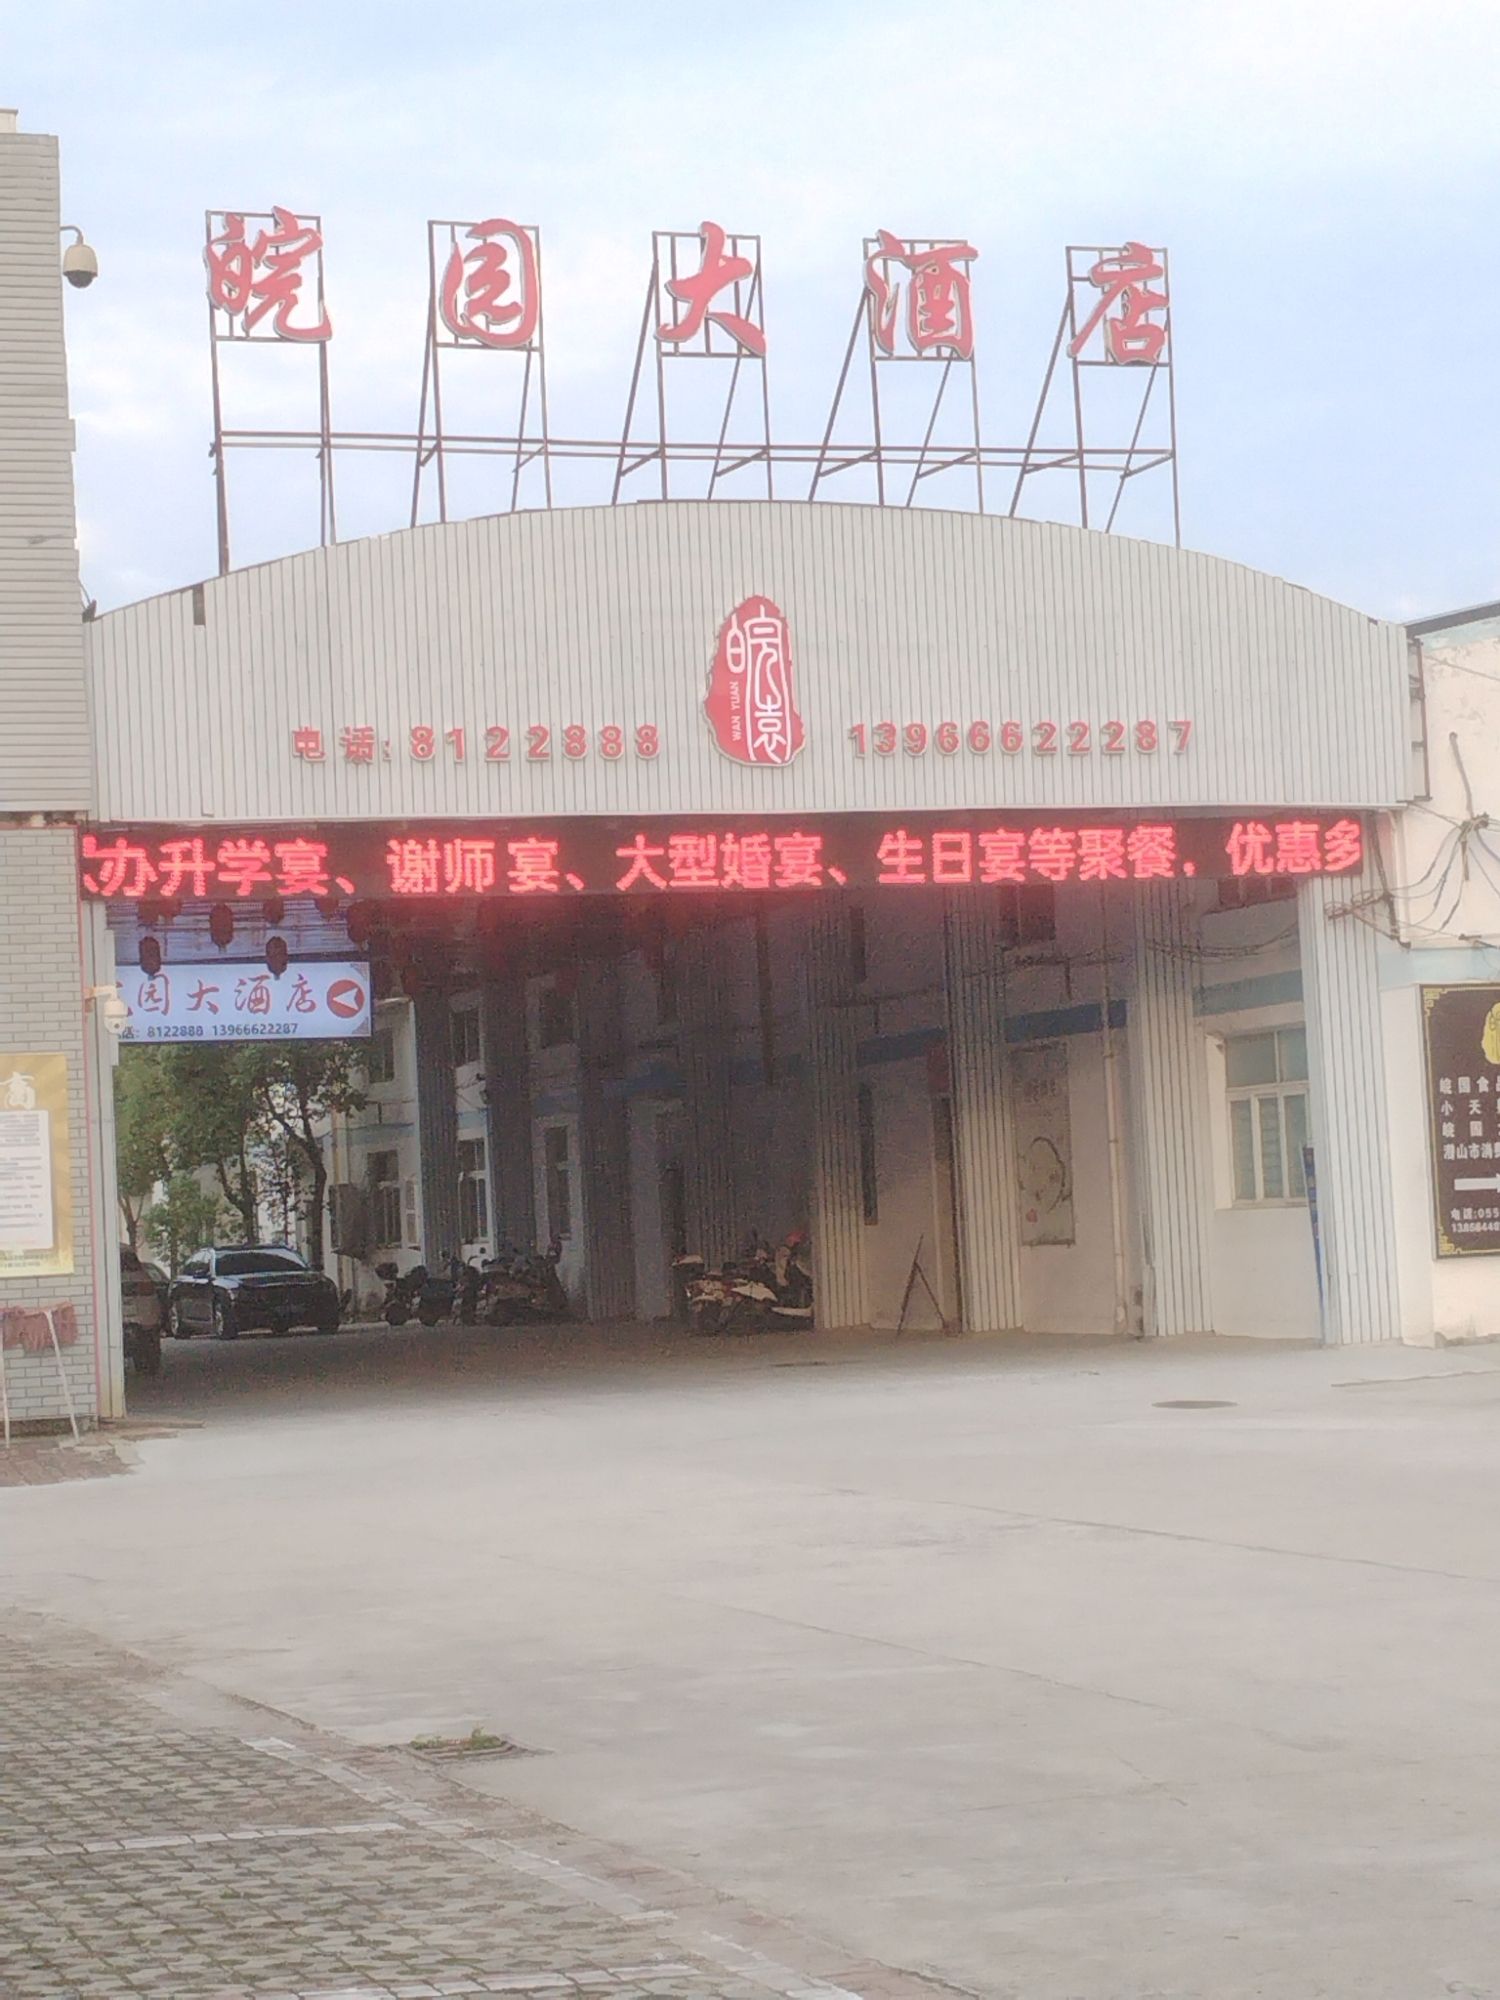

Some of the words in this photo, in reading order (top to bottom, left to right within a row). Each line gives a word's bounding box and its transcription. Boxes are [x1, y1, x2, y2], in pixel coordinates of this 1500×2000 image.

[205, 206, 1172, 367] 皖园大酒店
[849, 720, 1192, 757] 13966622287
[1225, 819, 1361, 876] 优惠多
[116, 972, 318, 1018] 园大酒店
[147, 1024, 204, 1038] 8122888
[212, 1022, 299, 1036] 13966622287
